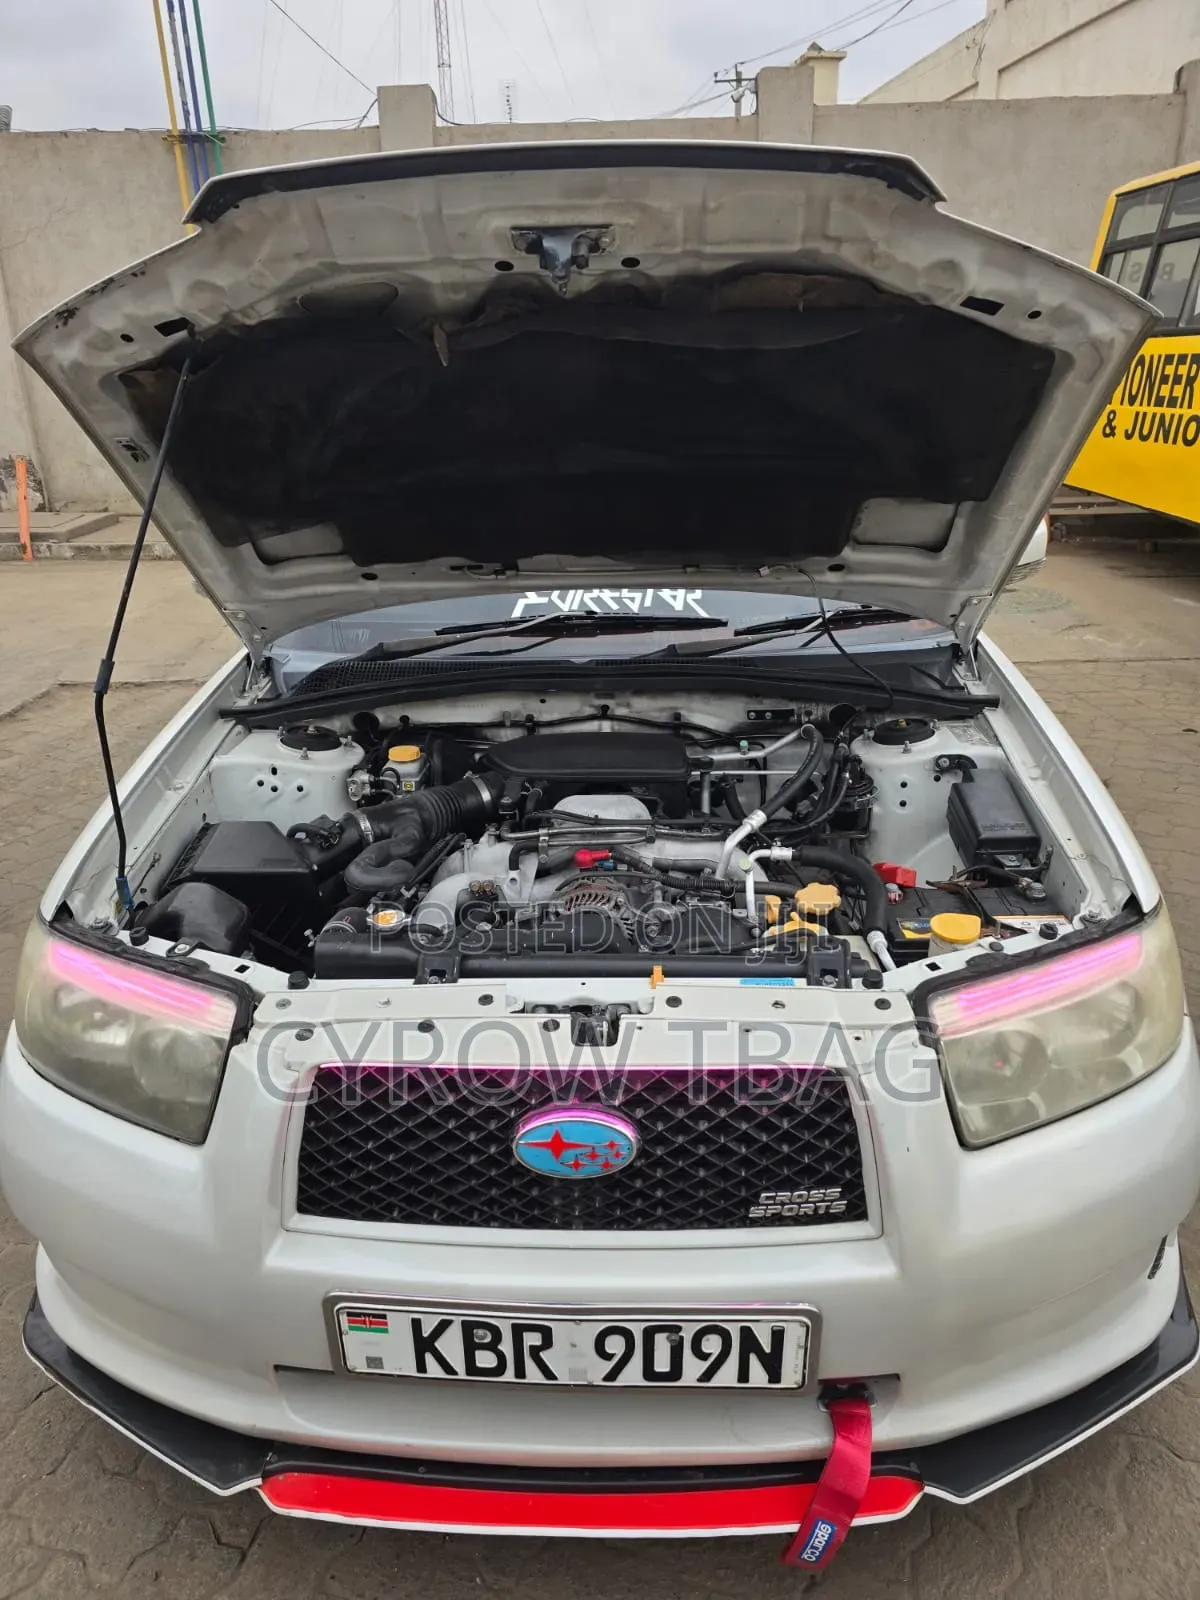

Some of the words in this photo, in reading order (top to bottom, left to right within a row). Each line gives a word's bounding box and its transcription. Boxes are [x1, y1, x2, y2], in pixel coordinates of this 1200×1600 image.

[1109, 353, 1200, 409] IONEER
[1102, 409, 1117, 438] &
[748, 1200, 848, 1218] SPORTS
[759, 1188, 842, 1205] CROSS
[411, 1317, 559, 1381] KBR
[594, 1323, 785, 1384] 909N
[803, 1523, 832, 1562] sparco
